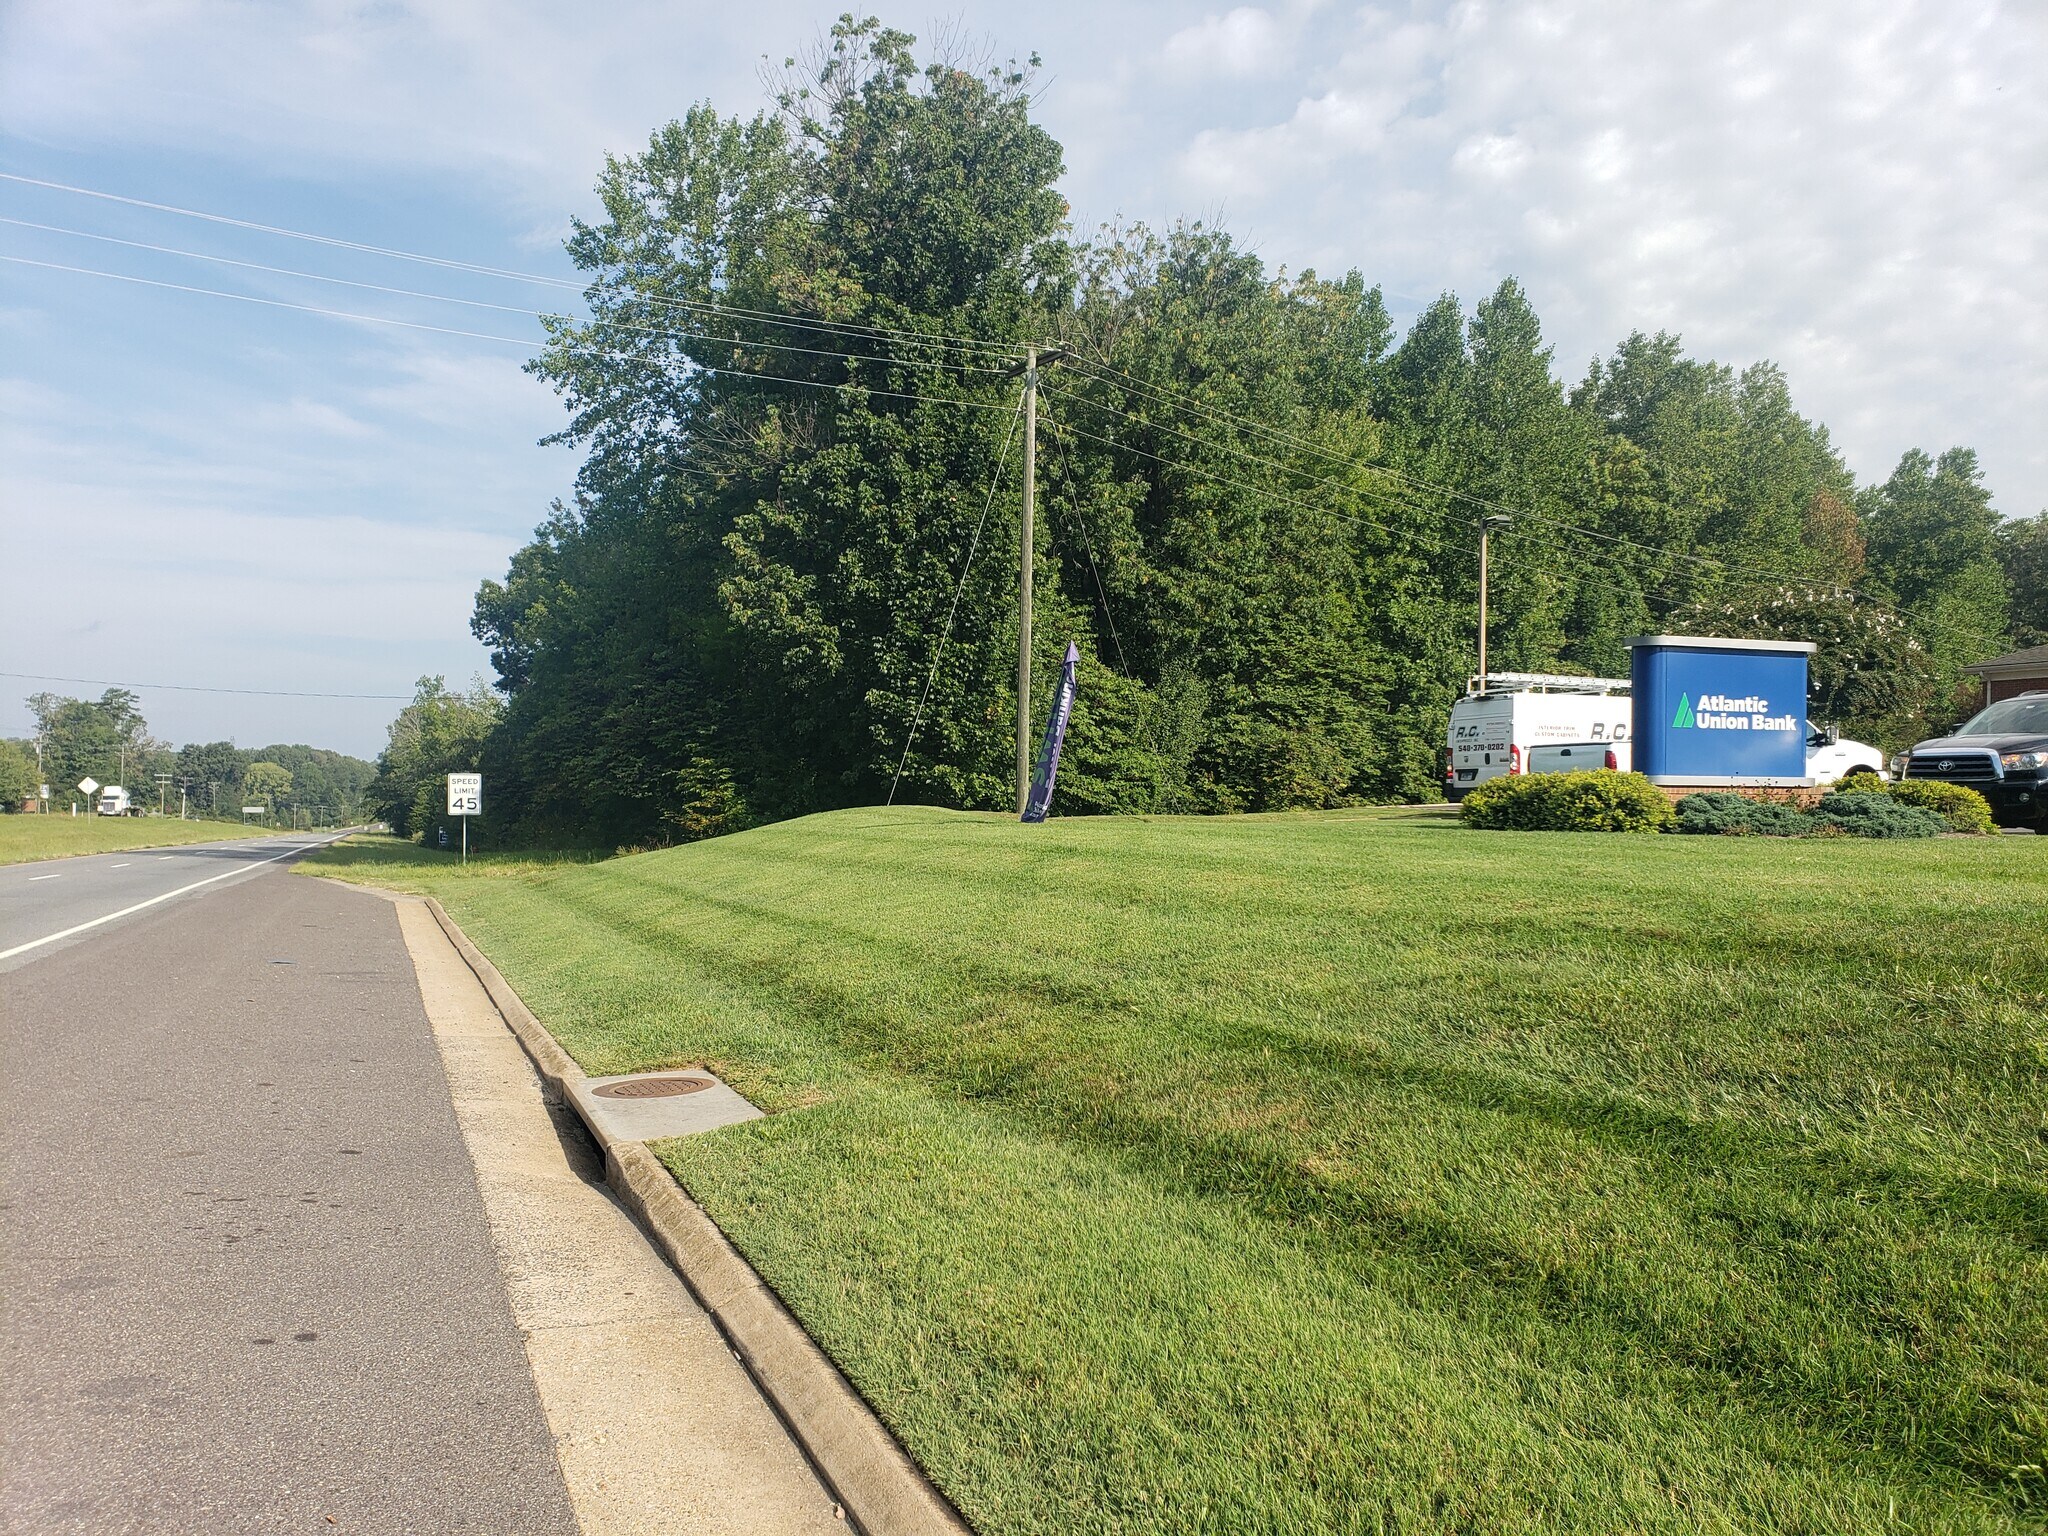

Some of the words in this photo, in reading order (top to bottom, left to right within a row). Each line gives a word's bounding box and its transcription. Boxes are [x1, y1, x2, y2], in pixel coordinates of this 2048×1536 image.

[1697, 695, 1768, 713] Atlantic
[1590, 722, 1632, 740] R.C.
[1696, 713, 1748, 730] Union
[1752, 714, 1797, 731] Bank
[1456, 726, 1478, 738] R.C.
[452, 797, 477, 810] 45
